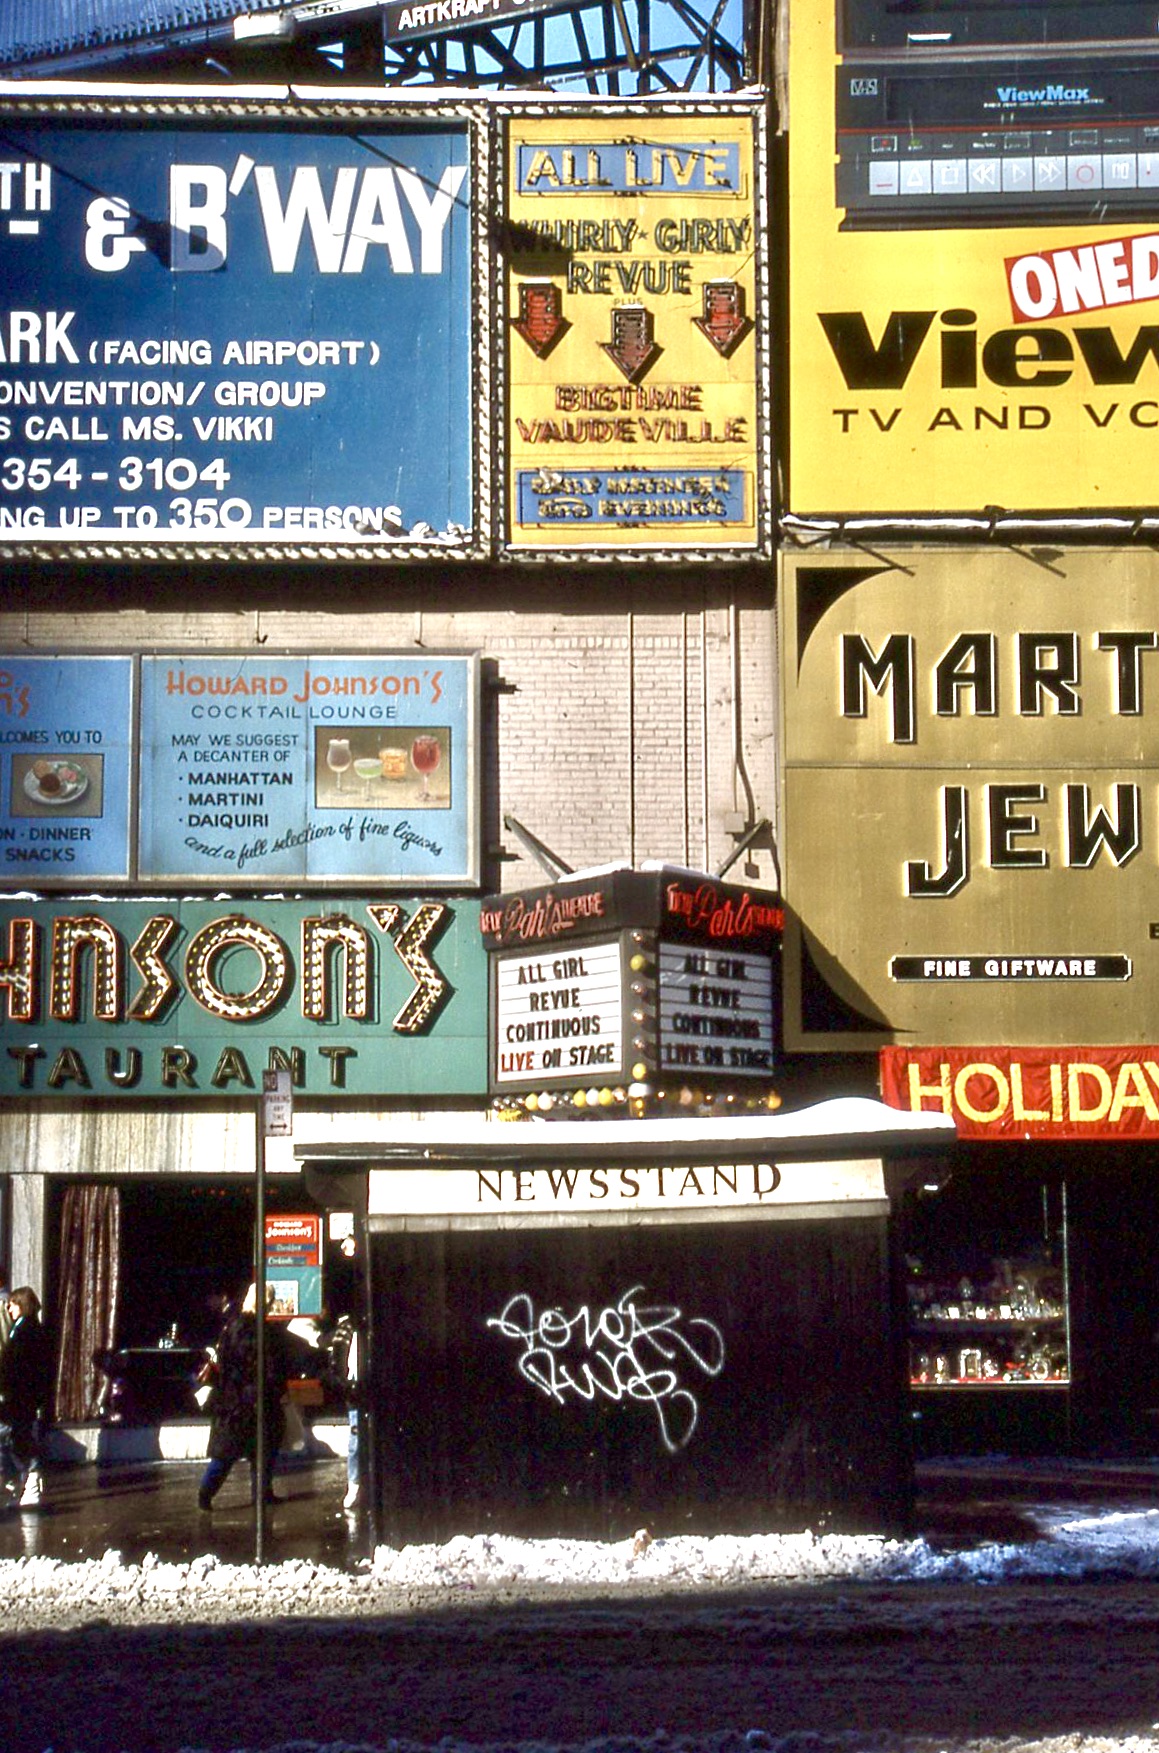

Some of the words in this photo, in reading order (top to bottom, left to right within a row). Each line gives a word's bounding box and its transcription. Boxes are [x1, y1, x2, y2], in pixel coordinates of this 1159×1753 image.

[850, 78, 878, 95] VHS
[997, 84, 1090, 102] ViewMax
[524, 149, 613, 187] ALL
[625, 148, 731, 188] LIVE
[85, 196, 147, 272] &
[170, 154, 468, 274] B'WAY
[654, 218, 750, 254] GIRLY
[566, 261, 693, 295] REVUE
[89, 340, 212, 366] (FACING
[222, 340, 381, 366] AIRPORT)
[214, 381, 326, 407] GROUP
[555, 385, 703, 412] BIGTIME
[25, 416, 109, 441] CALL
[122, 415, 183, 441] MS.
[193, 416, 273, 441] VIKKI
[515, 418, 748, 443] VAUDEVILLE
[833, 409, 902, 433] TV
[927, 405, 1051, 432] AND
[119, 456, 230, 491] 3104
[59, 506, 102, 528] UP
[113, 506, 158, 529] TO
[169, 497, 252, 529] 350
[263, 506, 402, 530] PERSONS
[840, 633, 1158, 743] MART
[191, 705, 301, 719] COCKTAIL
[310, 705, 397, 719] LOUNGE
[55, 731, 80, 744] YOU
[85, 731, 102, 744] TO
[171, 734, 201, 747] MAY
[208, 734, 231, 746] WE
[235, 734, 299, 747] SUGGEST
[178, 751, 188, 762] A
[194, 751, 269, 763] DECANTER
[273, 751, 291, 762] OF
[188, 773, 293, 785] MANHATTAN
[188, 793, 264, 806] MARTINI
[29, 828, 92, 841] DINNER
[188, 814, 269, 829] DAIQUIRI
[184, 836, 222, 859] and
[223, 849, 236, 860] a
[271, 822, 337, 853] selection
[339, 816, 353, 841] of
[360, 816, 389, 842] fine
[5, 847, 75, 862] SNACKS
[518, 963, 546, 985] ALL
[552, 956, 589, 980] GIRL
[923, 960, 971, 977] FINE
[984, 959, 1097, 976] GIFTWARE
[529, 987, 581, 1012] REVUE
[506, 1014, 601, 1043] CONTINUOUS
[8, 1046, 358, 1090] TAURANT
[500, 1050, 535, 1073] LIVE
[542, 1047, 562, 1069] ON
[569, 1042, 615, 1066] STAGE
[476, 1163, 782, 1202] NEWSSTAND
